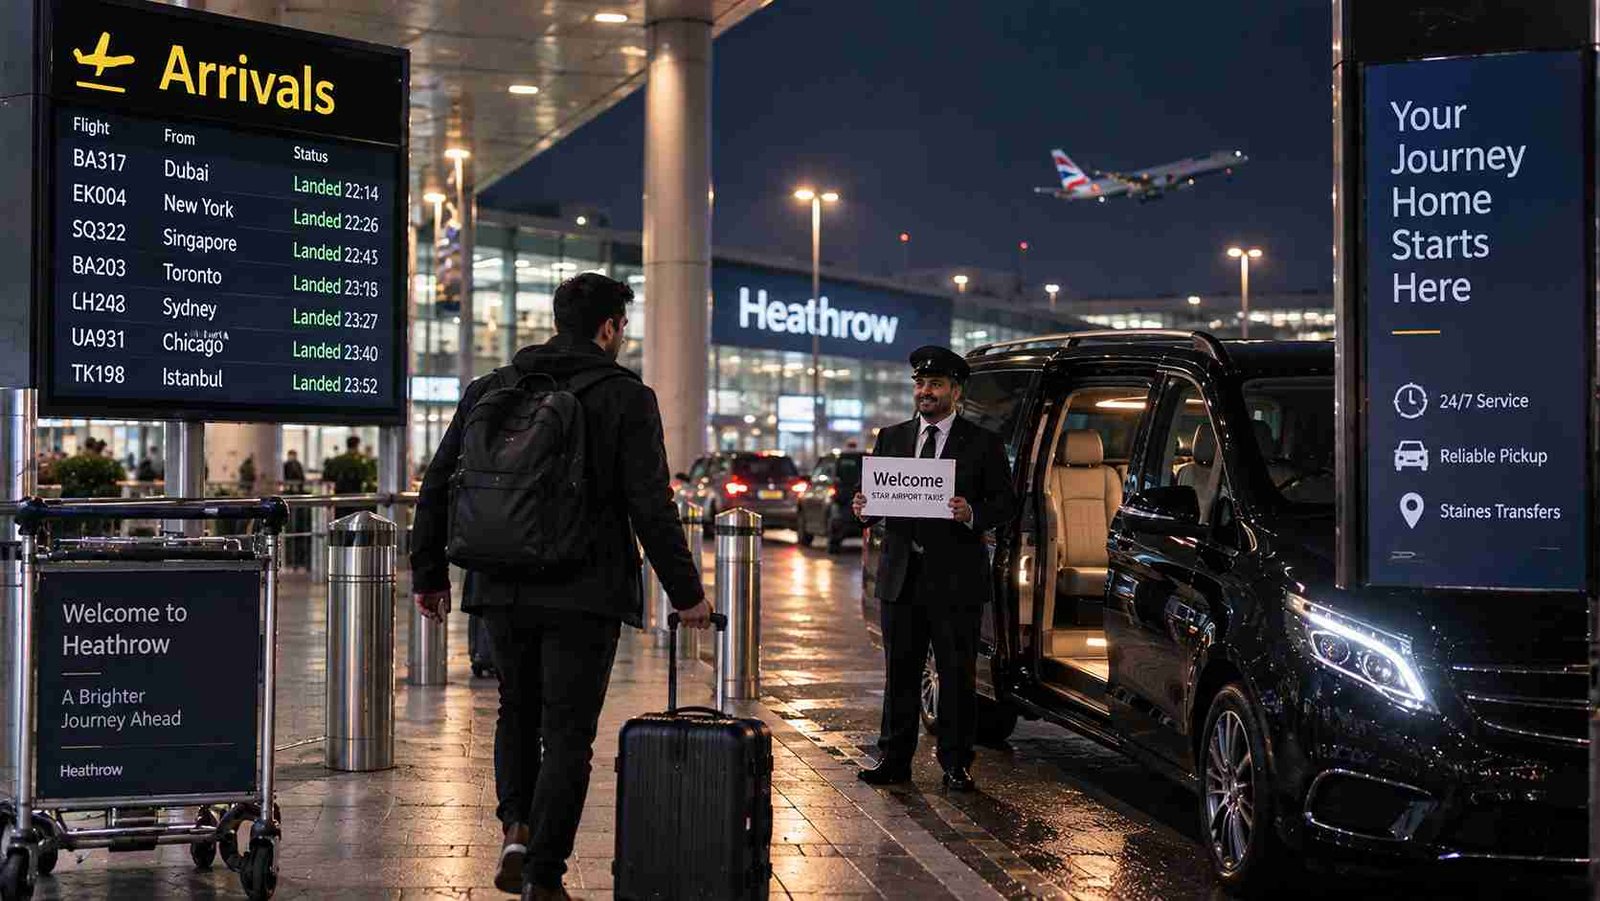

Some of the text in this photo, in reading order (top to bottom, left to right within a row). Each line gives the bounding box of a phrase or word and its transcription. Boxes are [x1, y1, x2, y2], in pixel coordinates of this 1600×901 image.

[159, 45, 334, 114] Arrivals
[74, 117, 110, 136] Flight
[1391, 101, 1466, 131] Your
[165, 129, 195, 145] From
[74, 149, 126, 171] BA317
[294, 146, 328, 162] Status
[1391, 144, 1526, 177] Journey
[165, 160, 208, 181] Dubai
[74, 184, 126, 206] EK004
[295, 176, 378, 200] Landed 22:14
[165, 194, 233, 218] New York
[1394, 187, 1491, 217] Home
[73, 220, 125, 241] SQ322
[294, 209, 378, 232] Landed 22:26
[164, 229, 236, 253] Singapore
[1392, 229, 1489, 260] Starts
[294, 242, 378, 265] Landed 22:45
[73, 256, 125, 276] BA203
[163, 263, 221, 284] Toronto
[294, 276, 341, 294] Landed
[1394, 273, 1470, 302] Here
[163, 298, 216, 321] Sydney
[294, 308, 377, 329] Landed 23:27
[740, 287, 898, 343] Heathrow
[73, 328, 123, 348] UA931
[163, 331, 224, 357] Chicago
[294, 341, 378, 361] Landed 23:40
[72, 364, 124, 383] TK198
[164, 368, 222, 387] Istanbul
[294, 375, 377, 393] Landed 23:52
[1440, 393, 1528, 410] 24/7 Service
[1441, 448, 1547, 466] Reliable Pickup
[874, 472, 943, 488] Welcome
[1441, 504, 1560, 519] Staines Transfers
[63, 603, 187, 623] Welcome to
[64, 634, 170, 655] Heathrow
[62, 688, 145, 708] A Brighter
[61, 710, 181, 731] Journey Ahead
[61, 764, 123, 777] Heathrow
